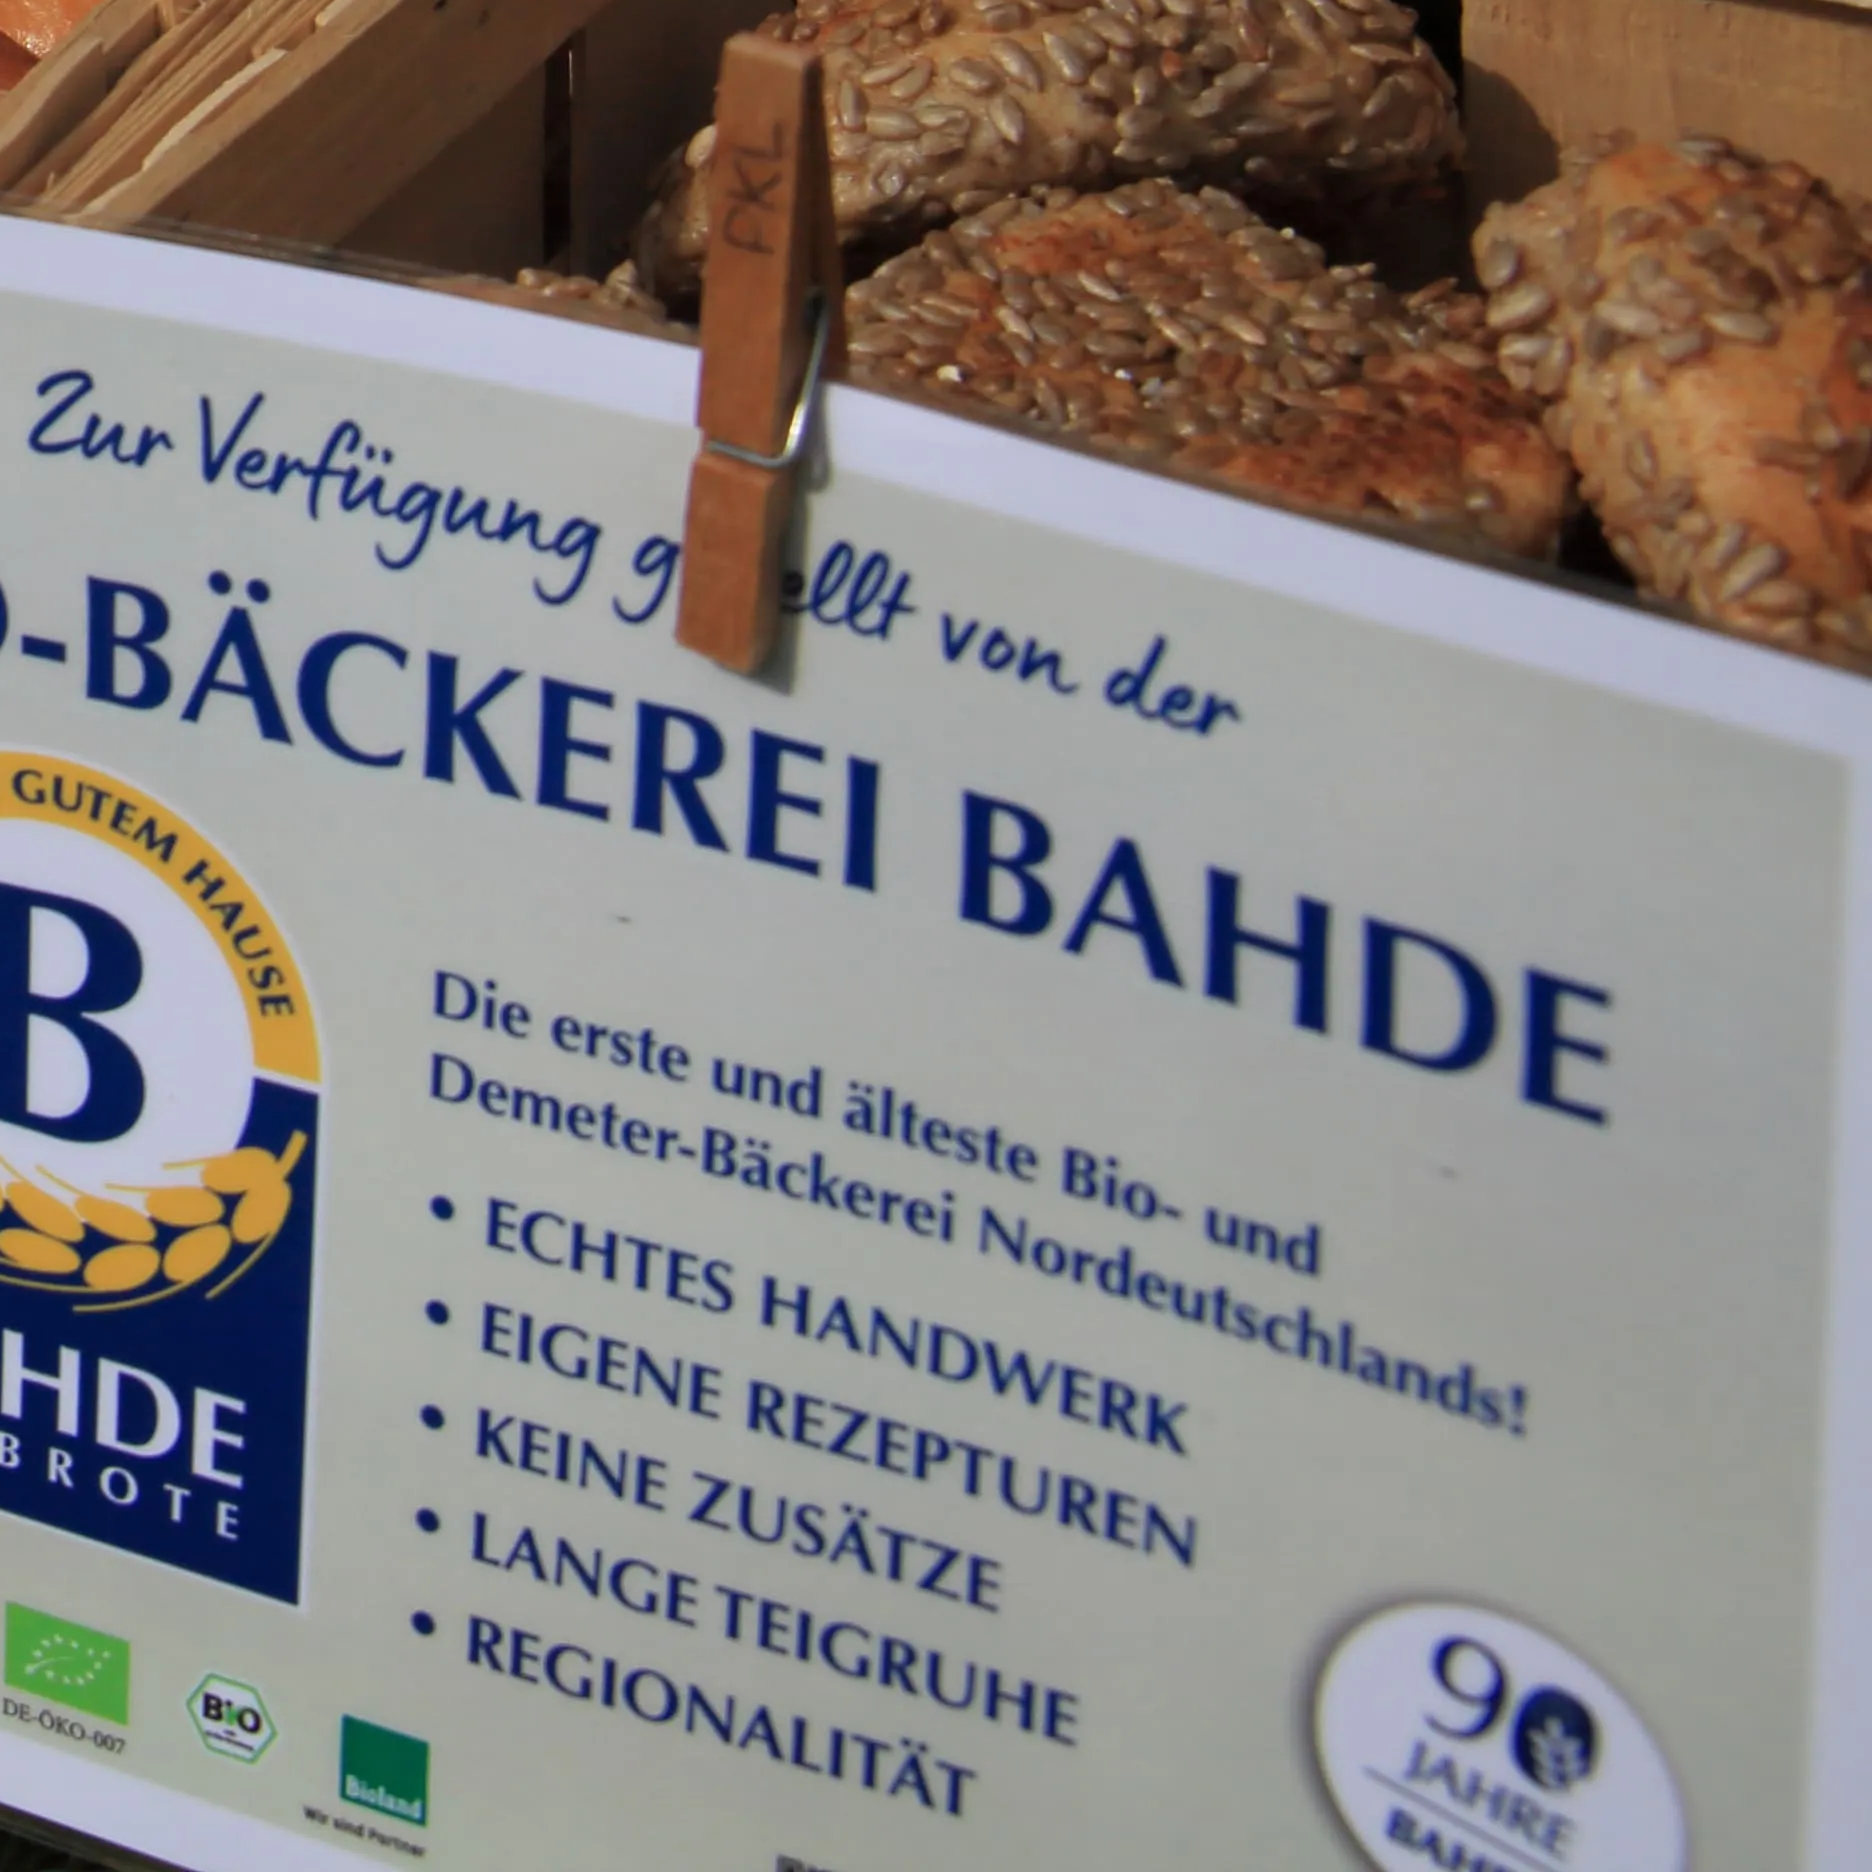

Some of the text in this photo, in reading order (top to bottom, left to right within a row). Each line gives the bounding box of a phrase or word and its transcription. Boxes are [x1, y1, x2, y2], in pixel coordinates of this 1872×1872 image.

[27, 369, 1241, 734] Zur Verfügung gellt von der
[12, 768, 177, 865] GUTEM
[182, 858, 295, 1018] HAUSE
[960, 789, 1613, 1125] BAHDE
[428, 1052, 1528, 1437] Demeter-Bäckerei Nordeutschlands!
[433, 967, 1321, 1277] Die erste und älteste Bio- und
[480, 1303, 1197, 1570] EIGENE REZEPTUREN
[484, 1197, 1190, 1458] ECHTES HANDWERK
[470, 1511, 1080, 1745] LANGE TEIGRUHE
[475, 1408, 1003, 1612] KEINE ZUSÄTZE
[1, 1697, 127, 1755] DE-ÖKO-007
[345, 1774, 422, 1820] Bioland
[466, 1614, 977, 1818] REGIONALITÄT
[1404, 1739, 1576, 1856] JAHRE
